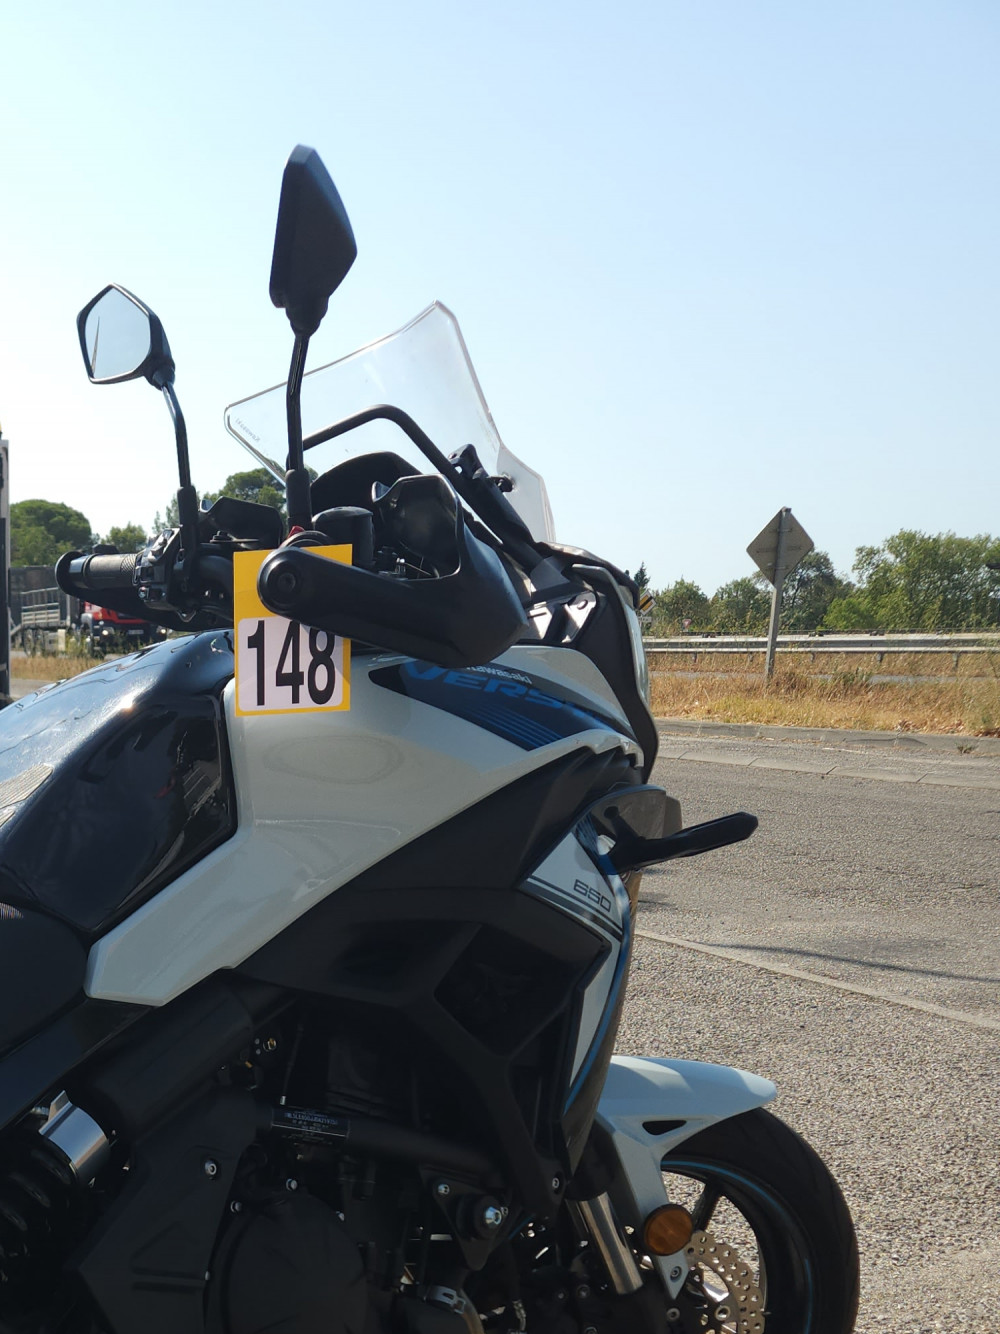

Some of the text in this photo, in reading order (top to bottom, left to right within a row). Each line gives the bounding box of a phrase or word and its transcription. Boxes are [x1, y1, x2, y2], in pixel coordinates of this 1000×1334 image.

[247, 619, 336, 706] 148
[466, 665, 533, 685] awasaki
[402, 660, 600, 722] VERS
[573, 878, 612, 913] 650
